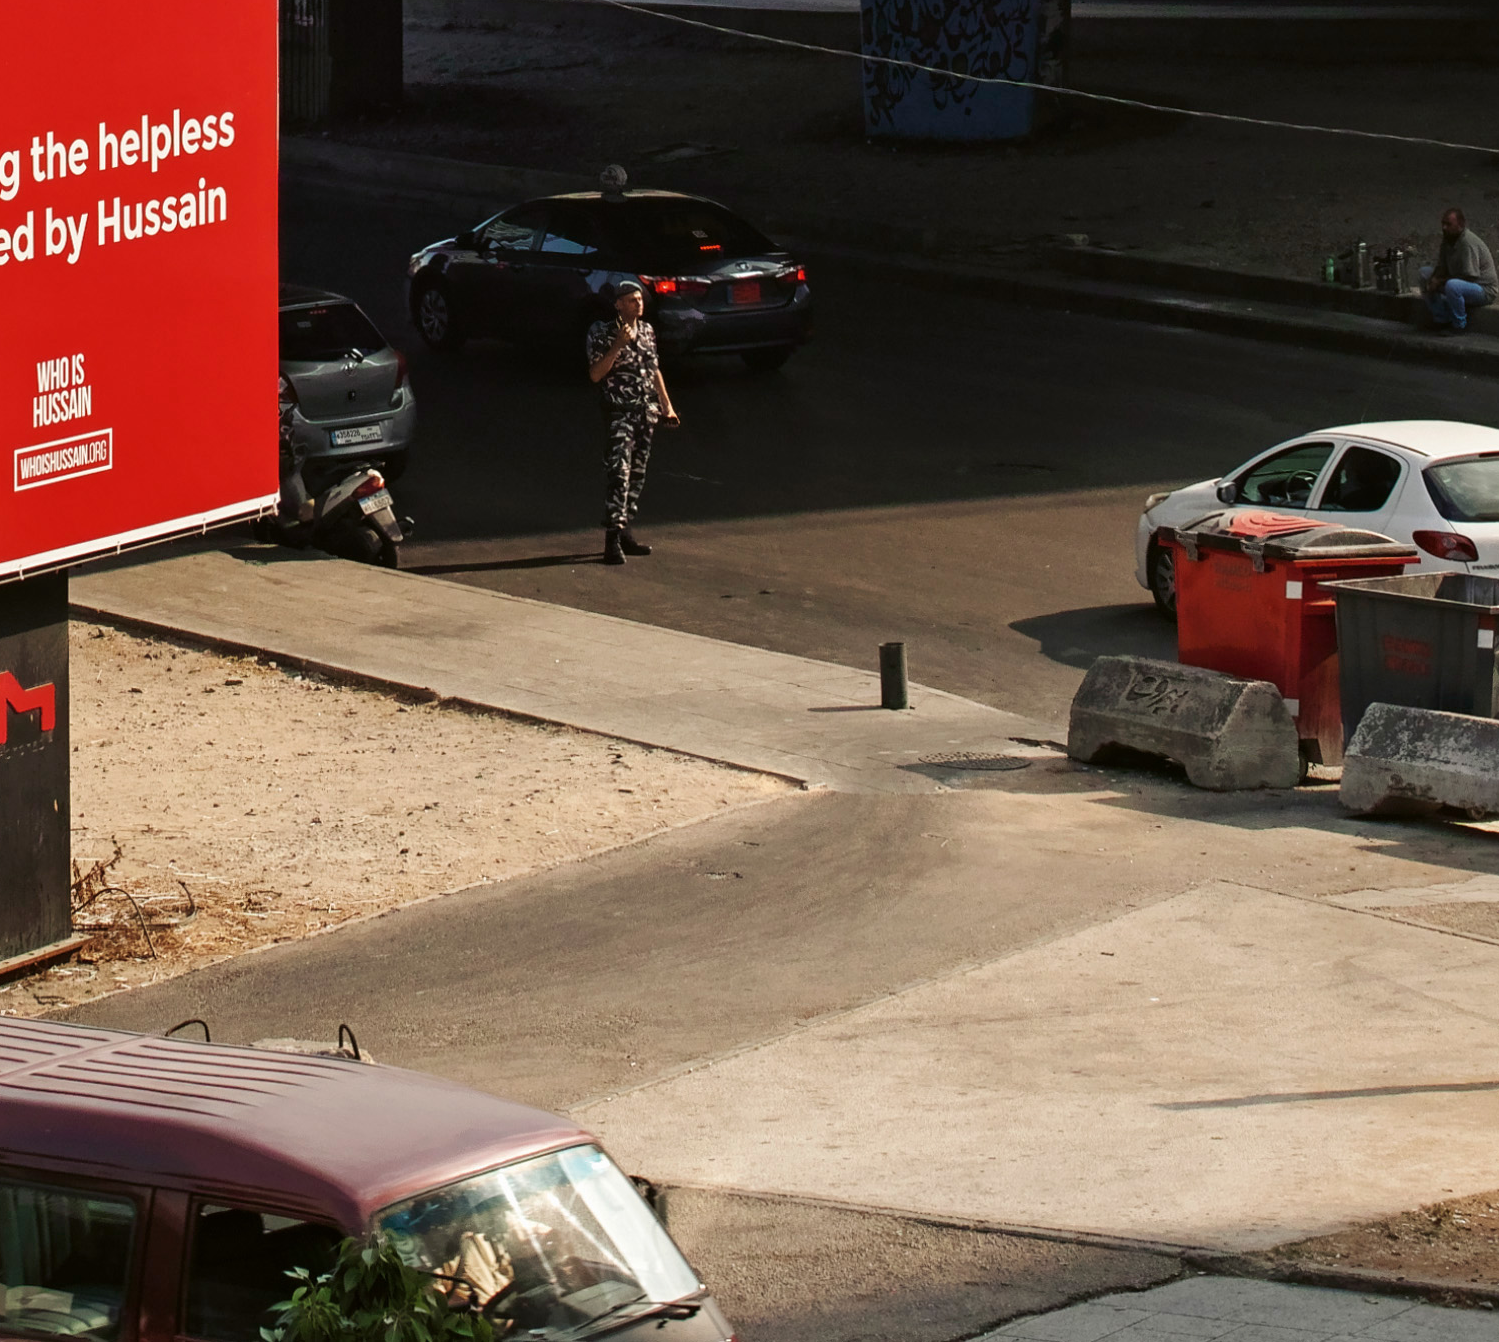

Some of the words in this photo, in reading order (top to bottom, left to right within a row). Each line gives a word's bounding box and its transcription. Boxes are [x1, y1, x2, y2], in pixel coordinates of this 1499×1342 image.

[30, 131, 88, 182] the
[98, 108, 236, 173] helpless
[44, 207, 88, 264] by
[97, 178, 228, 246] Hussain
[36, 356, 70, 393] WHO
[71, 352, 86, 387] IS
[32, 385, 92, 429] HUSSAIN
[20, 439, 107, 480] WHOISHUSSAIN.ORG
